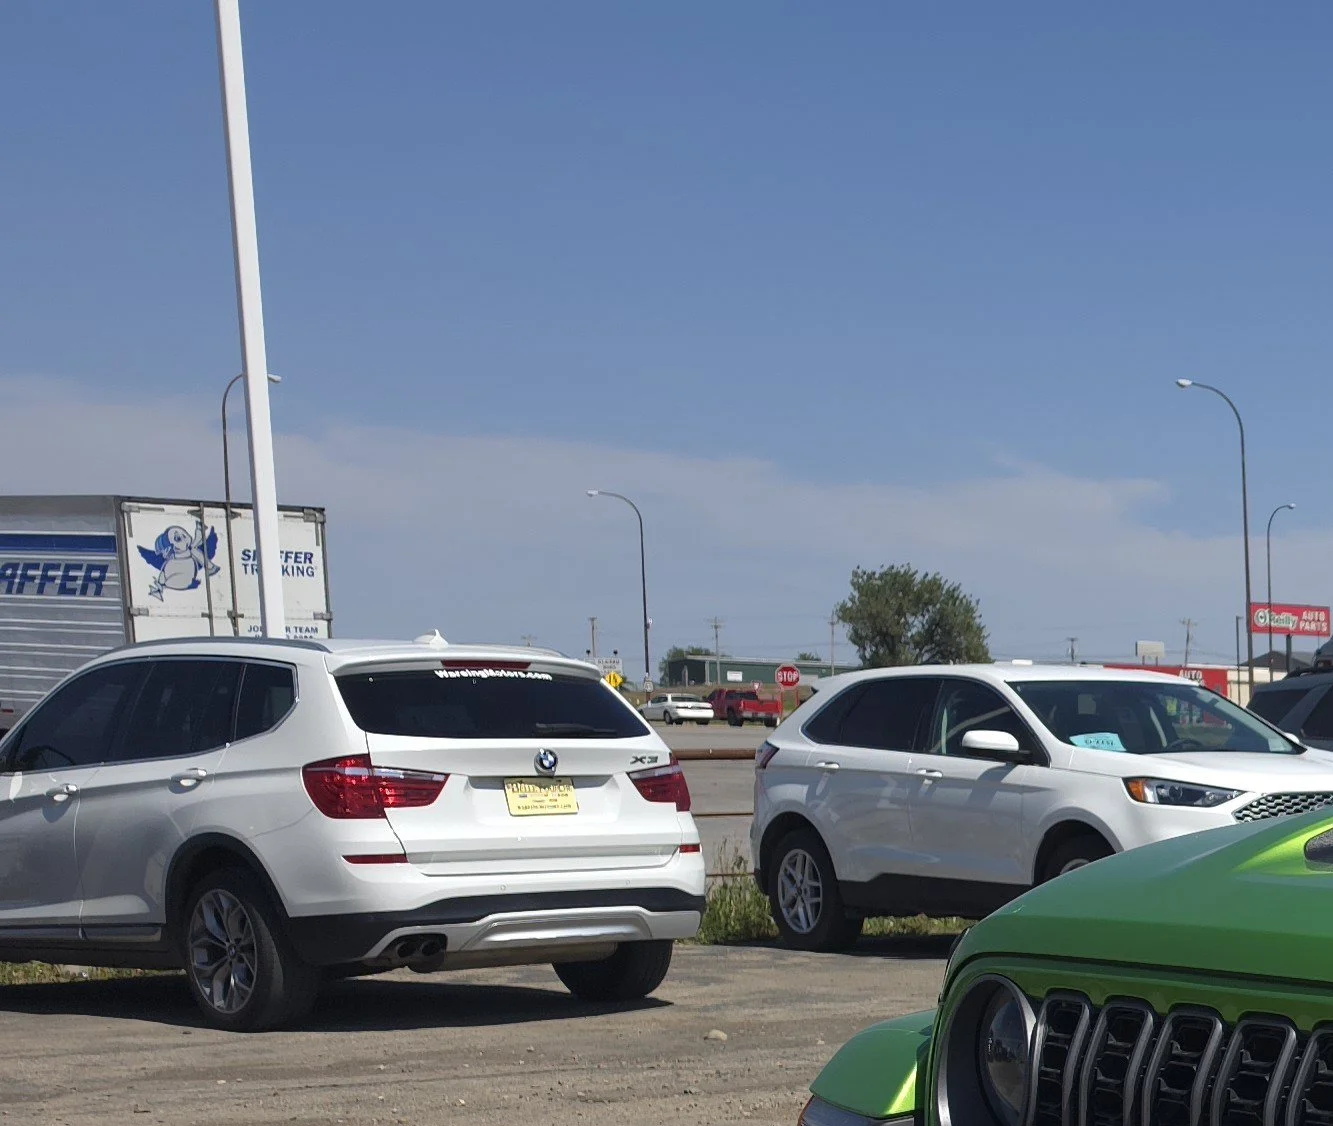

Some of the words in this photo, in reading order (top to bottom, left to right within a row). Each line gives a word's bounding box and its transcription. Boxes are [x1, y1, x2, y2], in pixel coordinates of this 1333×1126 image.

[1302, 610, 1326, 621] AUTO
[1299, 620, 1328, 632] PARTS
[777, 671, 799, 682] STOP
